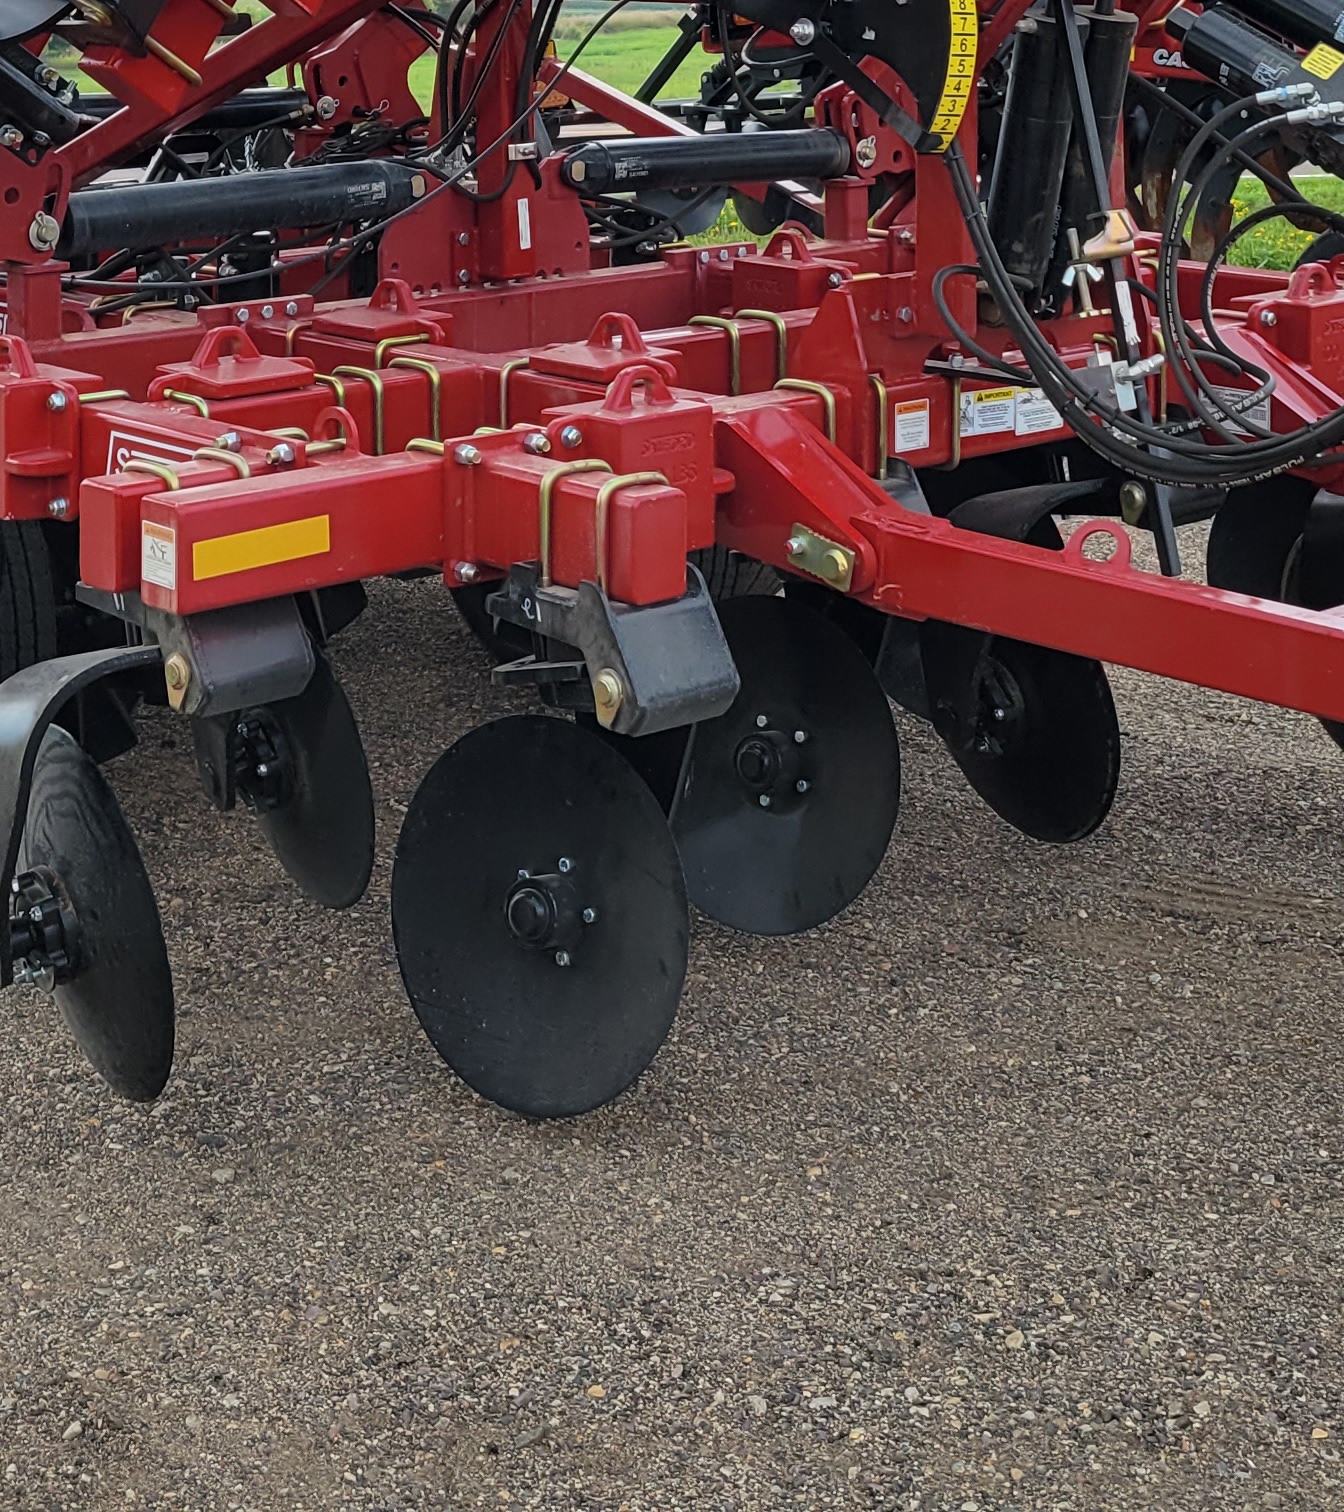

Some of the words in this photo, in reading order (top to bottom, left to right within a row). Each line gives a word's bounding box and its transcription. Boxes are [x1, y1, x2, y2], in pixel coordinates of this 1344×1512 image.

[960, 17, 968, 31] 7
[959, 37, 968, 52] 6
[957, 59, 966, 73] 5
[952, 80, 962, 93] 4
[947, 99, 957, 113] 3
[939, 118, 951, 131] 2
[983, 390, 1014, 400] IMPORTANT
